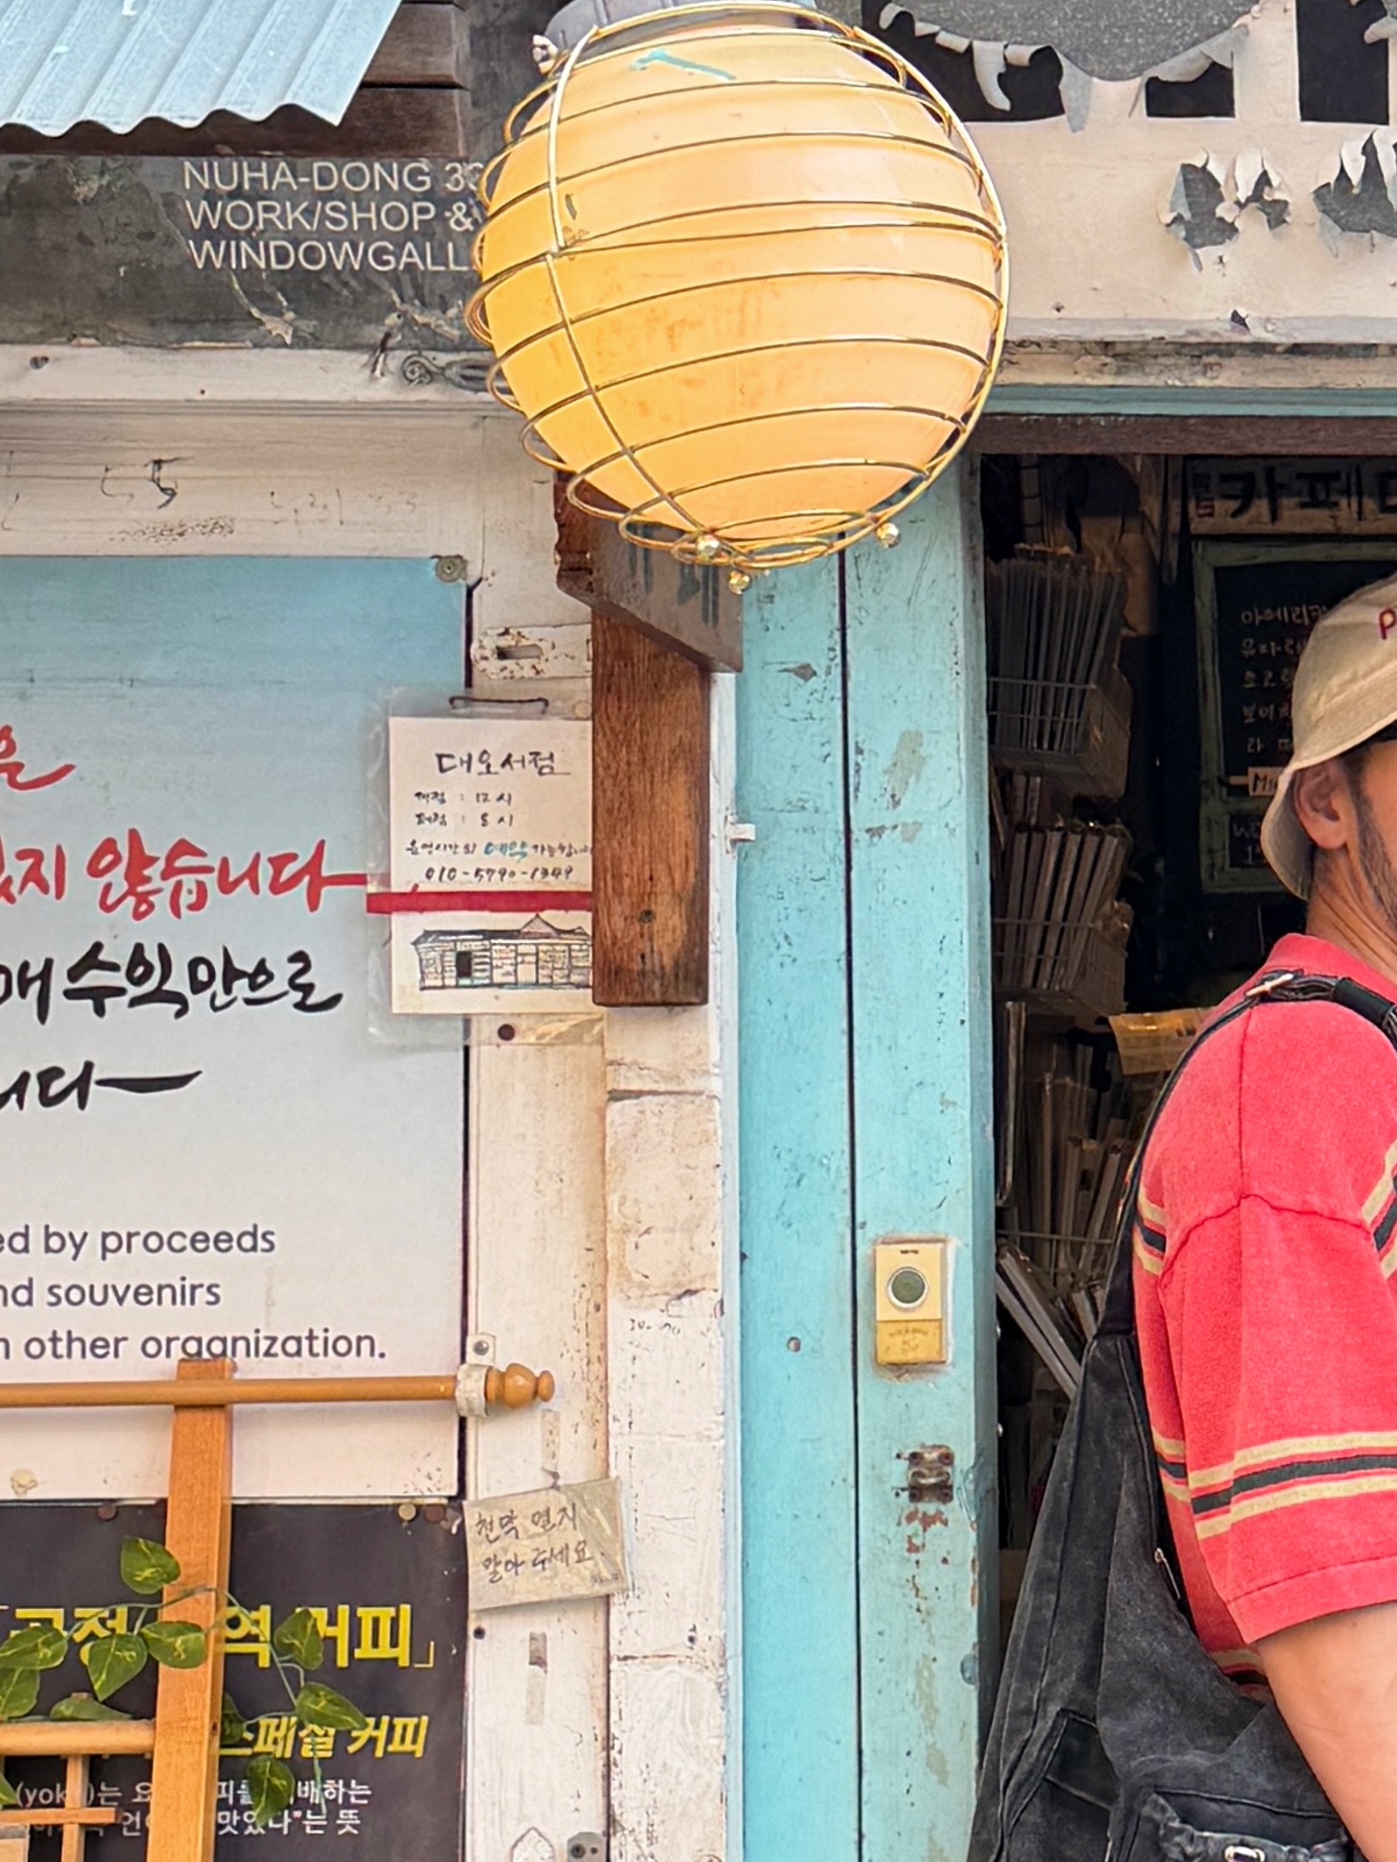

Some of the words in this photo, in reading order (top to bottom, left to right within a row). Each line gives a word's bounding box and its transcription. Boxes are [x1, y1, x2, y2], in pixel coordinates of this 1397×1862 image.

[183, 162, 432, 192] NUHA-DONG
[186, 200, 436, 232] WORK/SHOP
[449, 202, 474, 231] &
[188, 240, 474, 272] WINDOWGALL
[435, 749, 571, 777] 대오서점
[43, 1223, 89, 1262] by
[100, 1223, 277, 1262] proceeds
[46, 1275, 222, 1308] souvenirs
[23, 1328, 129, 1361] other
[140, 1326, 388, 1361] organization.
[481, 1552, 526, 1585] 말아
[531, 1539, 595, 1573] 주세요
[16, 1780, 123, 1808] (yok)는
[288, 1779, 372, 1804] 배하는
